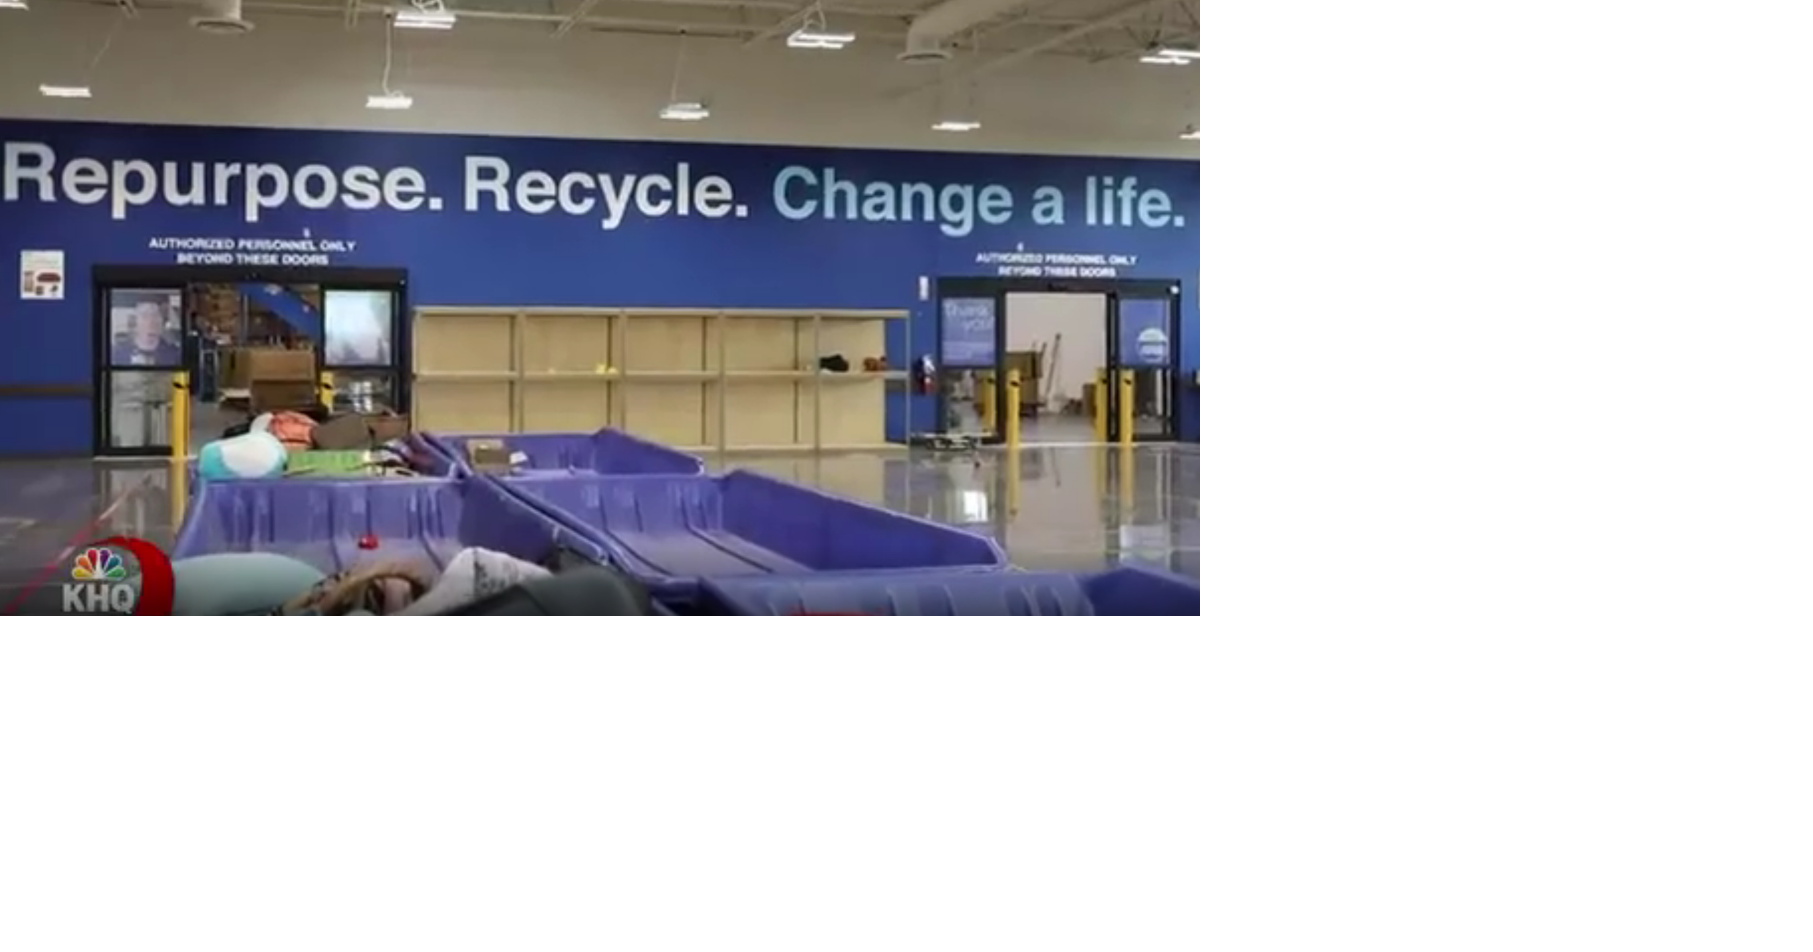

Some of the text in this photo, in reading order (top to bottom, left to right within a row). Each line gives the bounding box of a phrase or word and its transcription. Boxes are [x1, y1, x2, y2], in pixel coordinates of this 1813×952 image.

[4, 142, 1185, 236] Repurpose. Recycle. Change a life.
[149, 237, 356, 252] AUTHORIZED PERSONNEL ONLY
[177, 252, 329, 266] BEYOND THESE DOORS
[975, 252, 1138, 266] AUTHORIZED PERSONNEL ONLY
[998, 265, 1117, 278] BEYOND THESE DOORS
